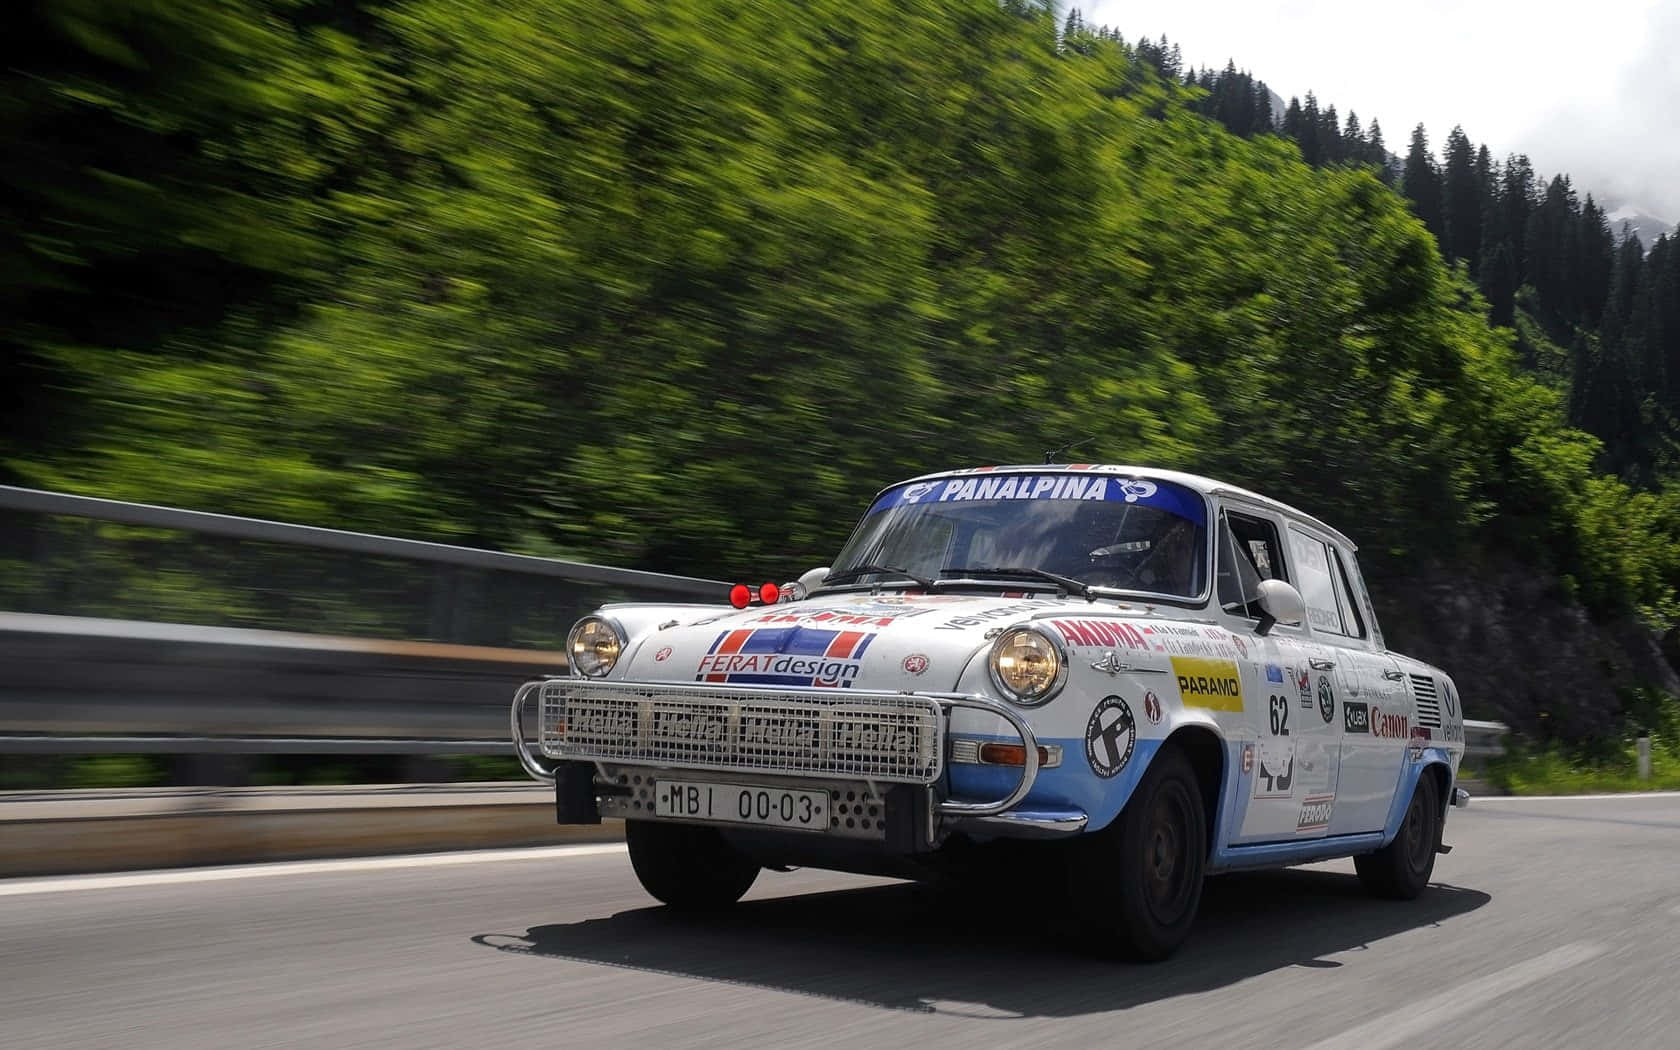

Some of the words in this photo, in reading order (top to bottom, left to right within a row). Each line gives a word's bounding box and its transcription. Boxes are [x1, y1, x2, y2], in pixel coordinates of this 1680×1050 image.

[939, 476, 1108, 501] PANALPINA
[1051, 620, 1150, 650] AKUMA
[698, 655, 861, 682] FERATdesign
[1178, 676, 1240, 697] PARAMO
[657, 712, 724, 742] Hella
[1270, 695, 1290, 736] 62
[1371, 706, 1408, 740] Canon
[746, 717, 815, 746] Hella
[836, 723, 913, 753] Hella
[669, 785, 713, 817] MBI
